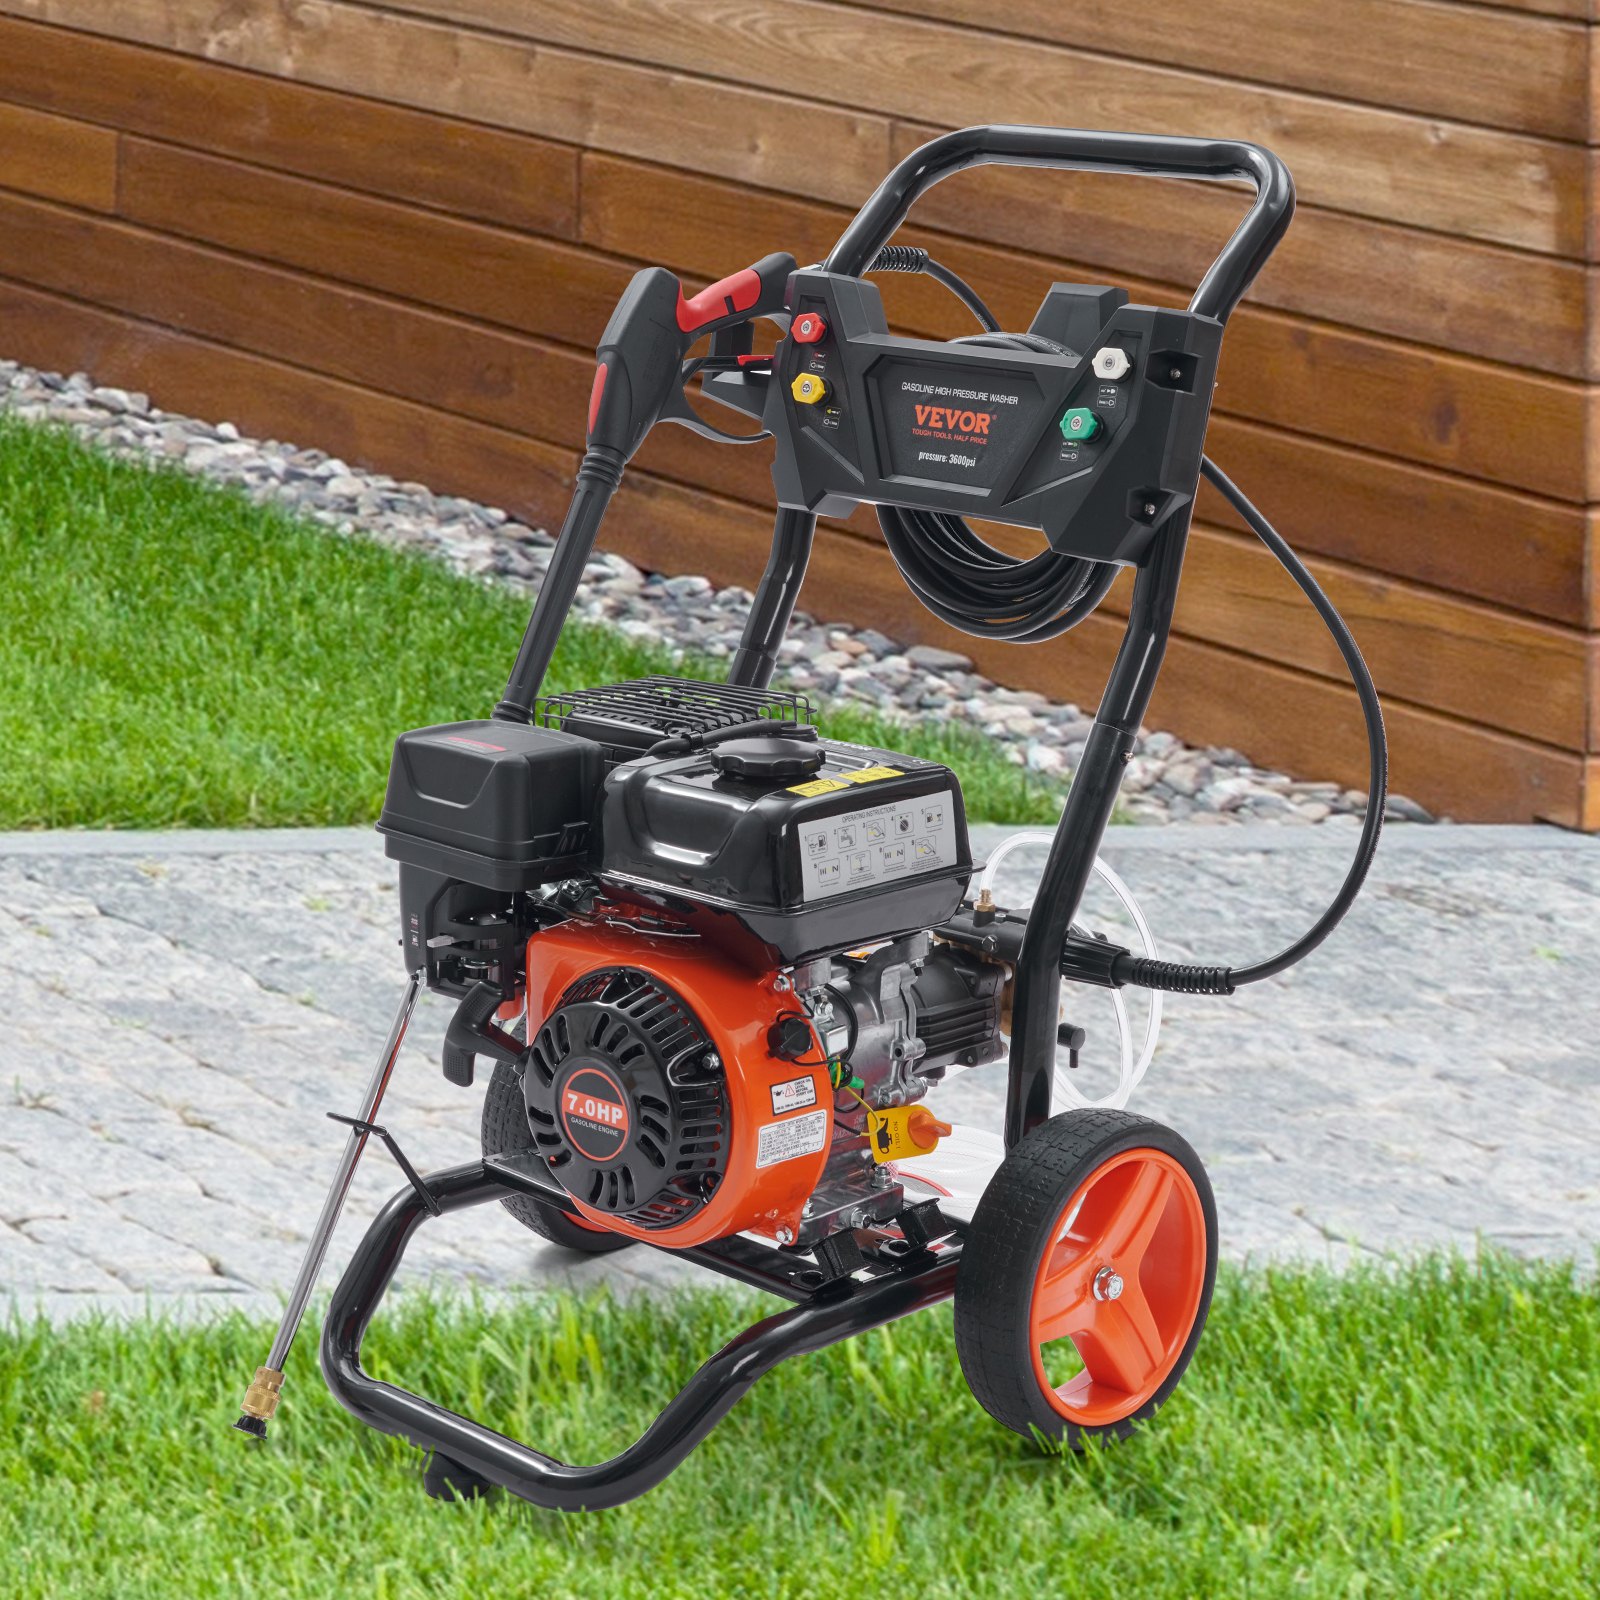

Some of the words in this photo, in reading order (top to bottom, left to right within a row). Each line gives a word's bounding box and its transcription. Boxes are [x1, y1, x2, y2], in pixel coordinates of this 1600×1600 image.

[901, 381, 934, 394] GASOLINE
[935, 386, 952, 396] HIGH
[952, 388, 988, 401] PRESSURE
[989, 393, 1019, 405] WASHER
[914, 404, 991, 434] VEVOR
[912, 427, 932, 437] TOUGH
[933, 430, 953, 441] TOOLS,
[953, 434, 969, 442] HALF
[969, 436, 988, 445] PRICE
[918, 451, 948, 463] pressure:
[948, 453, 977, 468] 3600psi
[842, 811, 866, 823] OPERATING
[866, 805, 897, 818] INSTRUCTIONS
[567, 1093, 623, 1124] 7.0HP
[570, 1117, 597, 1130] GASOLINE
[598, 1124, 618, 1136] ENGINE
[893, 1120, 899, 1132] NO
